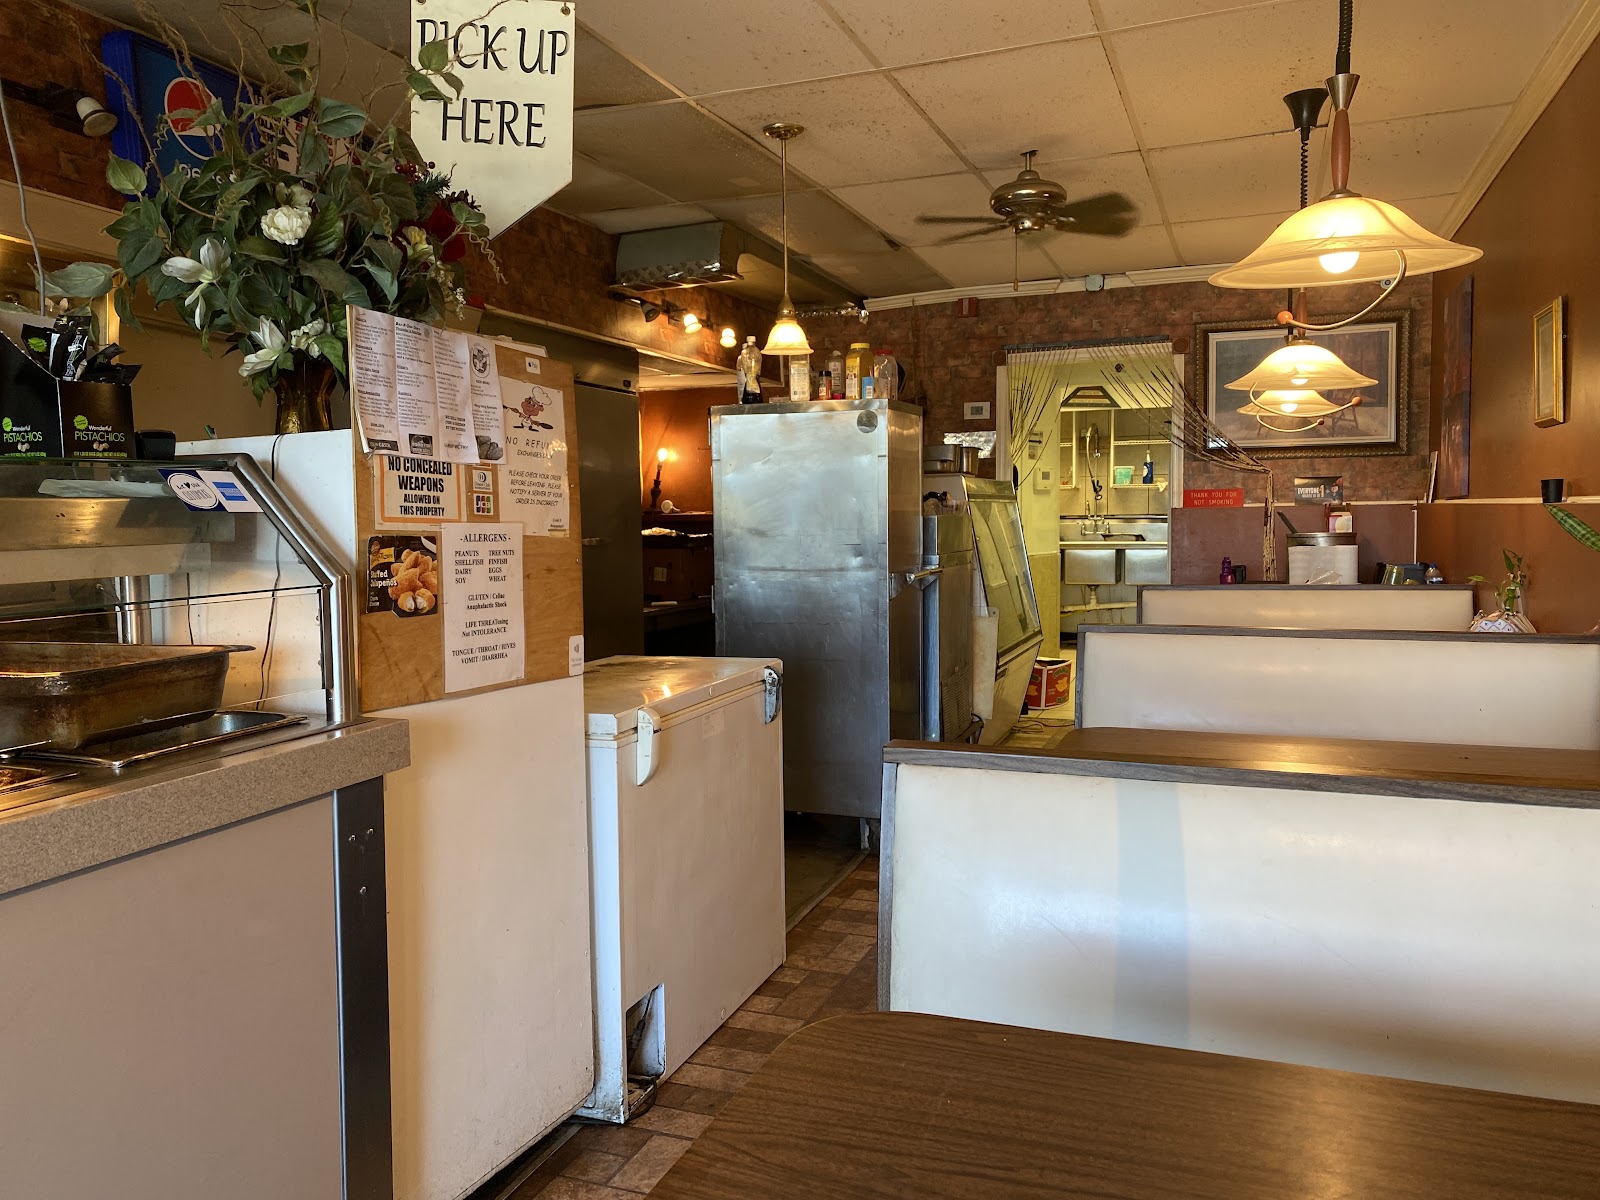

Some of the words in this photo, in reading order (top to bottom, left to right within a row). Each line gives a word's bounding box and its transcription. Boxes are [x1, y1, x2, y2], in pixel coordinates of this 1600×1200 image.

[416, 19, 508, 72] PICK
[517, 28, 569, 75] UP
[442, 98, 547, 149] HERE
[3, 432, 43, 442] PISTACHIOS
[75, 431, 125, 442] PISTACHIOS
[505, 436, 518, 446] NO
[387, 455, 401, 472] NO
[403, 458, 452, 476] CONCEALED
[509, 469, 525, 477] PLEASE
[398, 475, 444, 493] WEAPONS
[510, 478, 526, 487] BEFORE
[547, 482, 561, 490] PLEASE
[510, 488, 527, 496] NOTIFY
[403, 494, 432, 504] ALLOWED
[432, 495, 440, 505] ON
[515, 497, 529, 505] ORDER
[536, 499, 559, 507] INCORRECT
[400, 505, 415, 515] THIS
[415, 506, 445, 517] PROPERTY
[468, 593, 489, 601] GLUTEN
[471, 626, 507, 637] INTOLERANCE
[452, 647, 475, 657] TONGUE
[477, 644, 499, 654] THROAT
[461, 656, 479, 664] VOMIT
[482, 652, 508, 662] DIARRHEA
